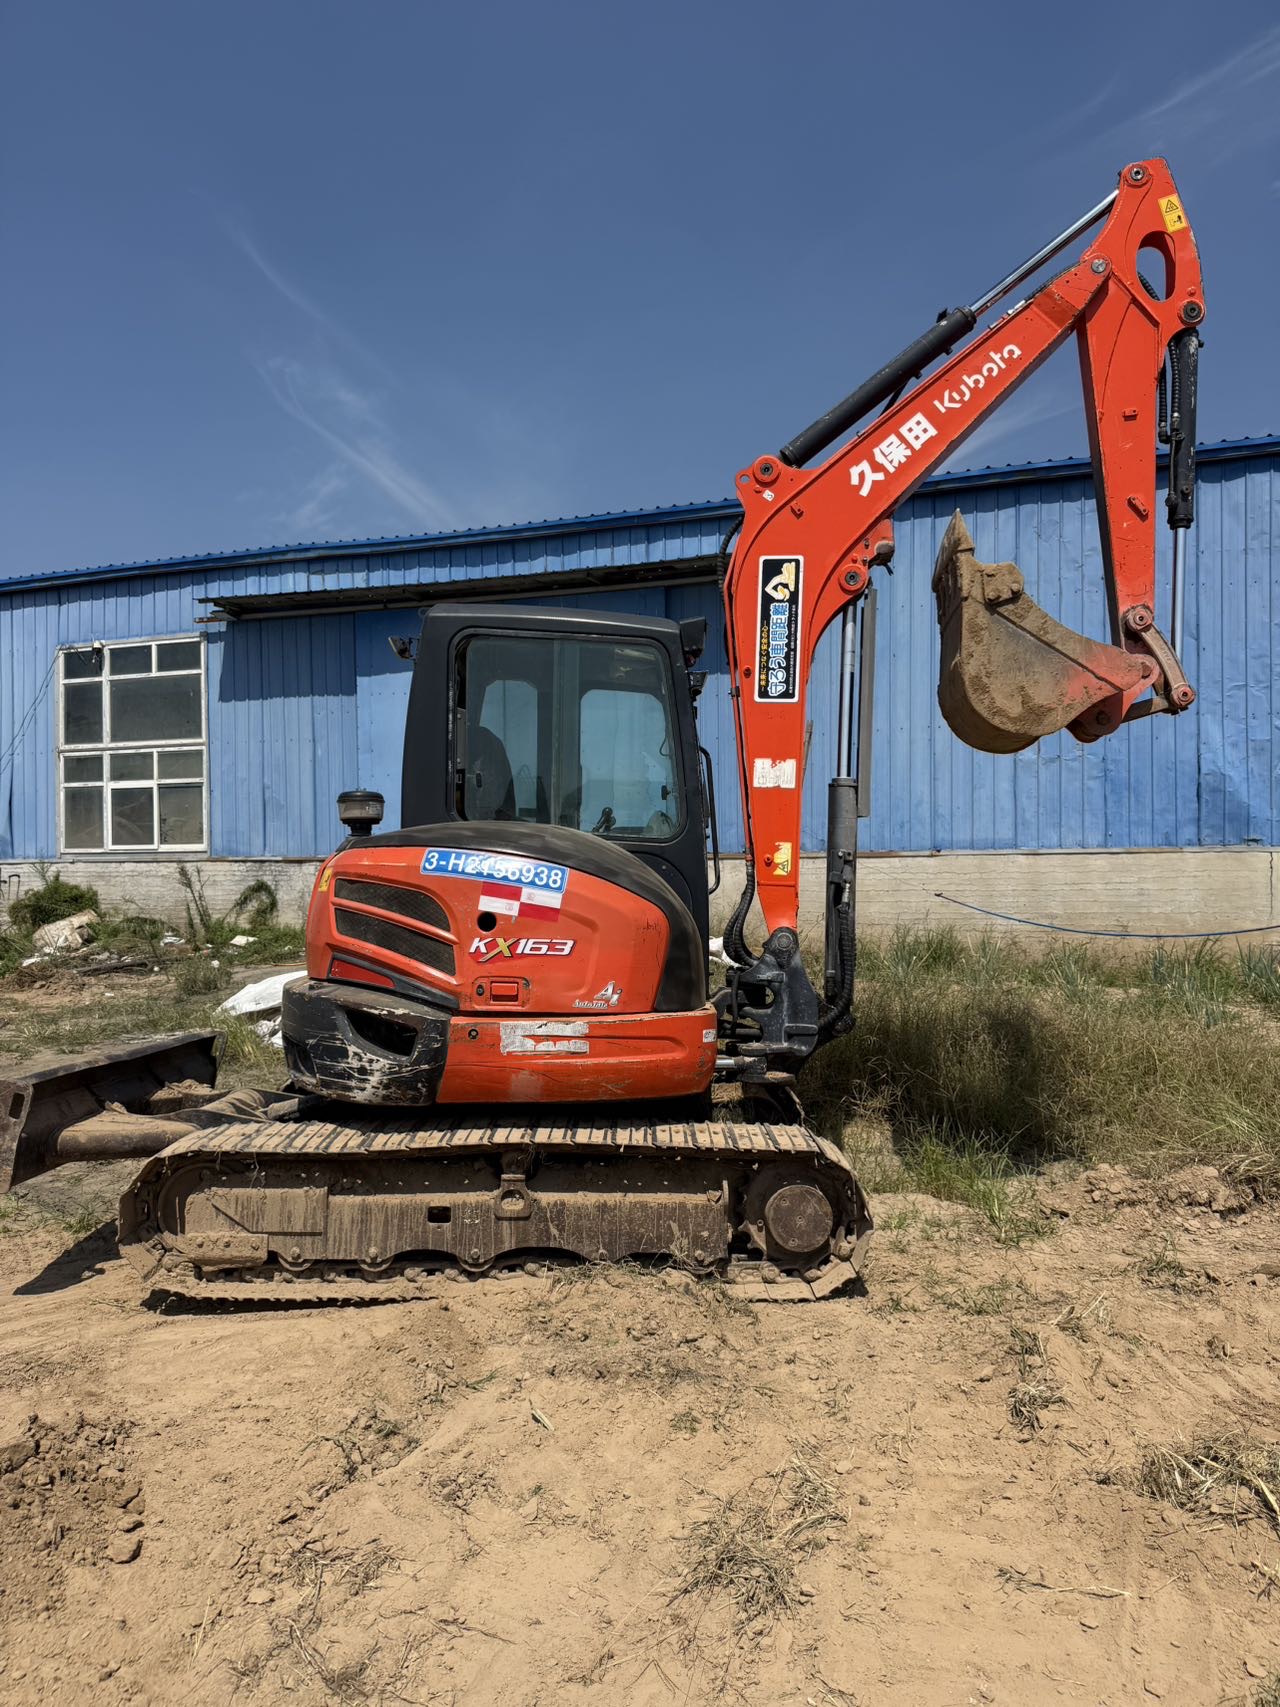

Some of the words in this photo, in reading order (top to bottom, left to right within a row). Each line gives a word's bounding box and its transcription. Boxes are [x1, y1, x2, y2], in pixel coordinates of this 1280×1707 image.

[933, 344, 1022, 414] Kubota
[849, 411, 938, 497] 久保田
[767, 602, 789, 697] 守ろう車間距離
[469, 937, 575, 962] KX163
